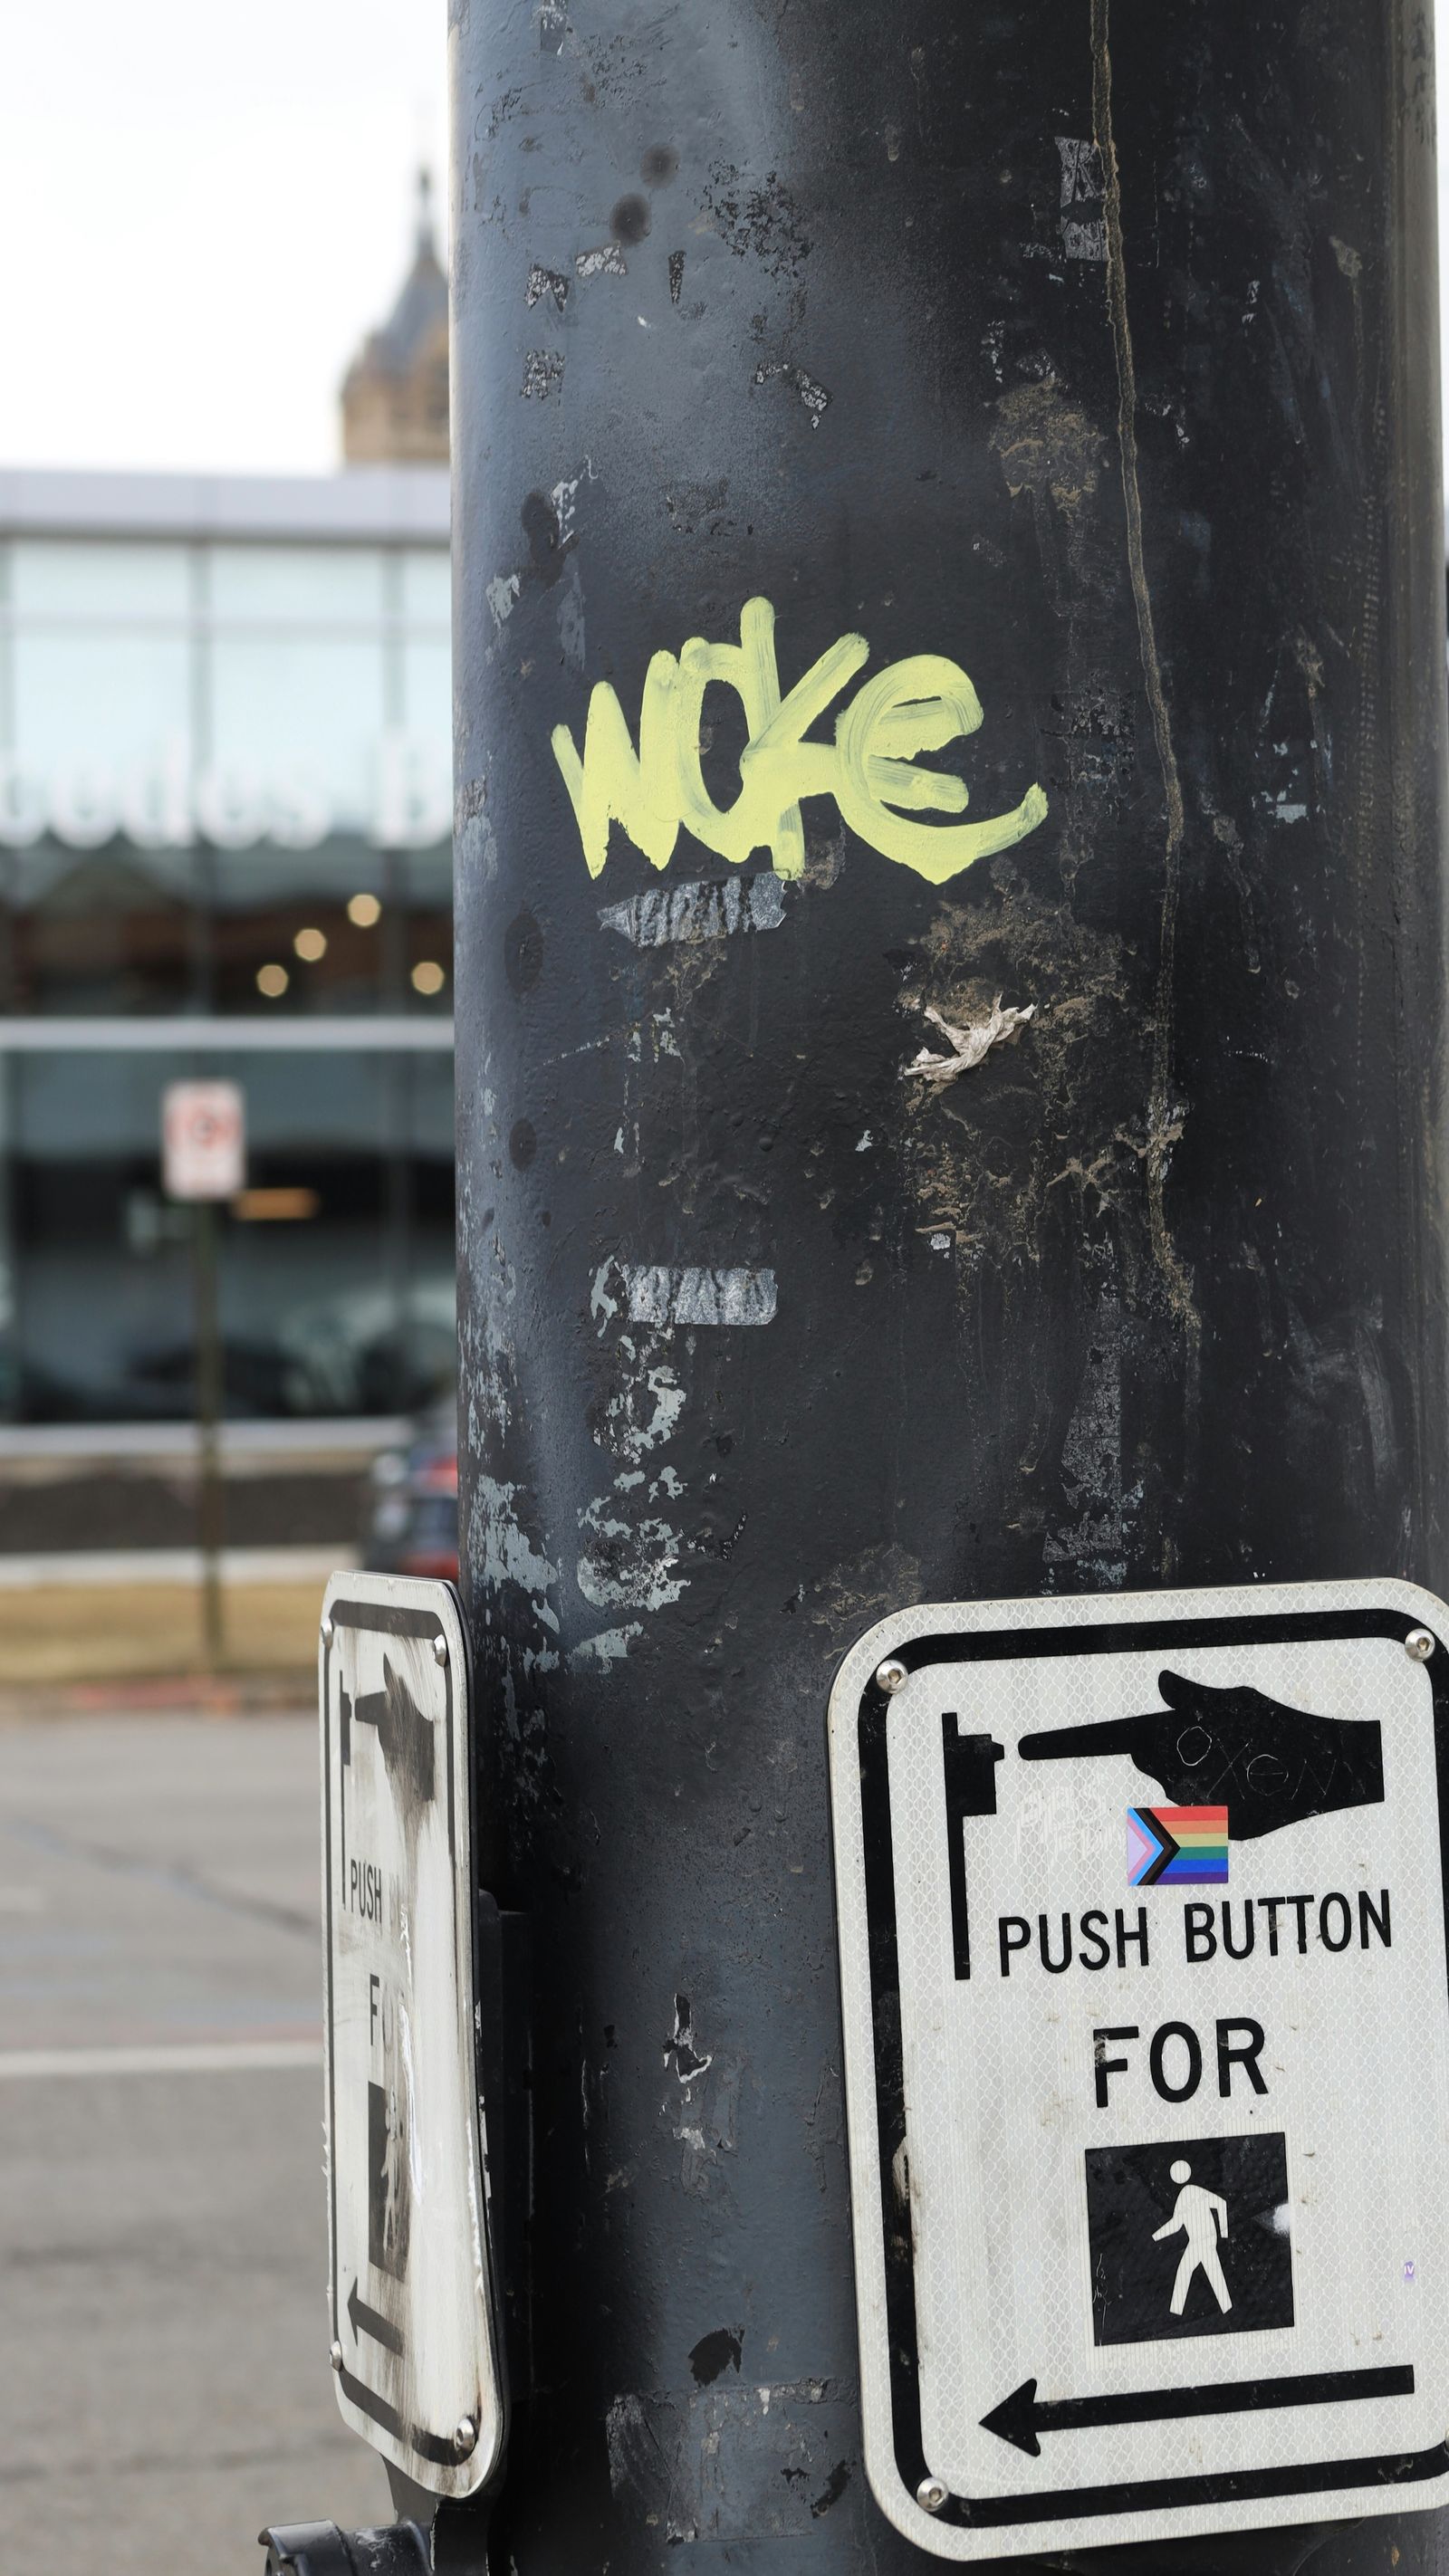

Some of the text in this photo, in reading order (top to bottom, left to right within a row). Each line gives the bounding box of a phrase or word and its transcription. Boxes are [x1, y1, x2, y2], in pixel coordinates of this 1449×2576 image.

[350, 1859, 382, 1924] PUSH
[998, 1889, 1392, 1977] PUSH BUTTON
[1092, 2017, 1269, 2108] FOR
